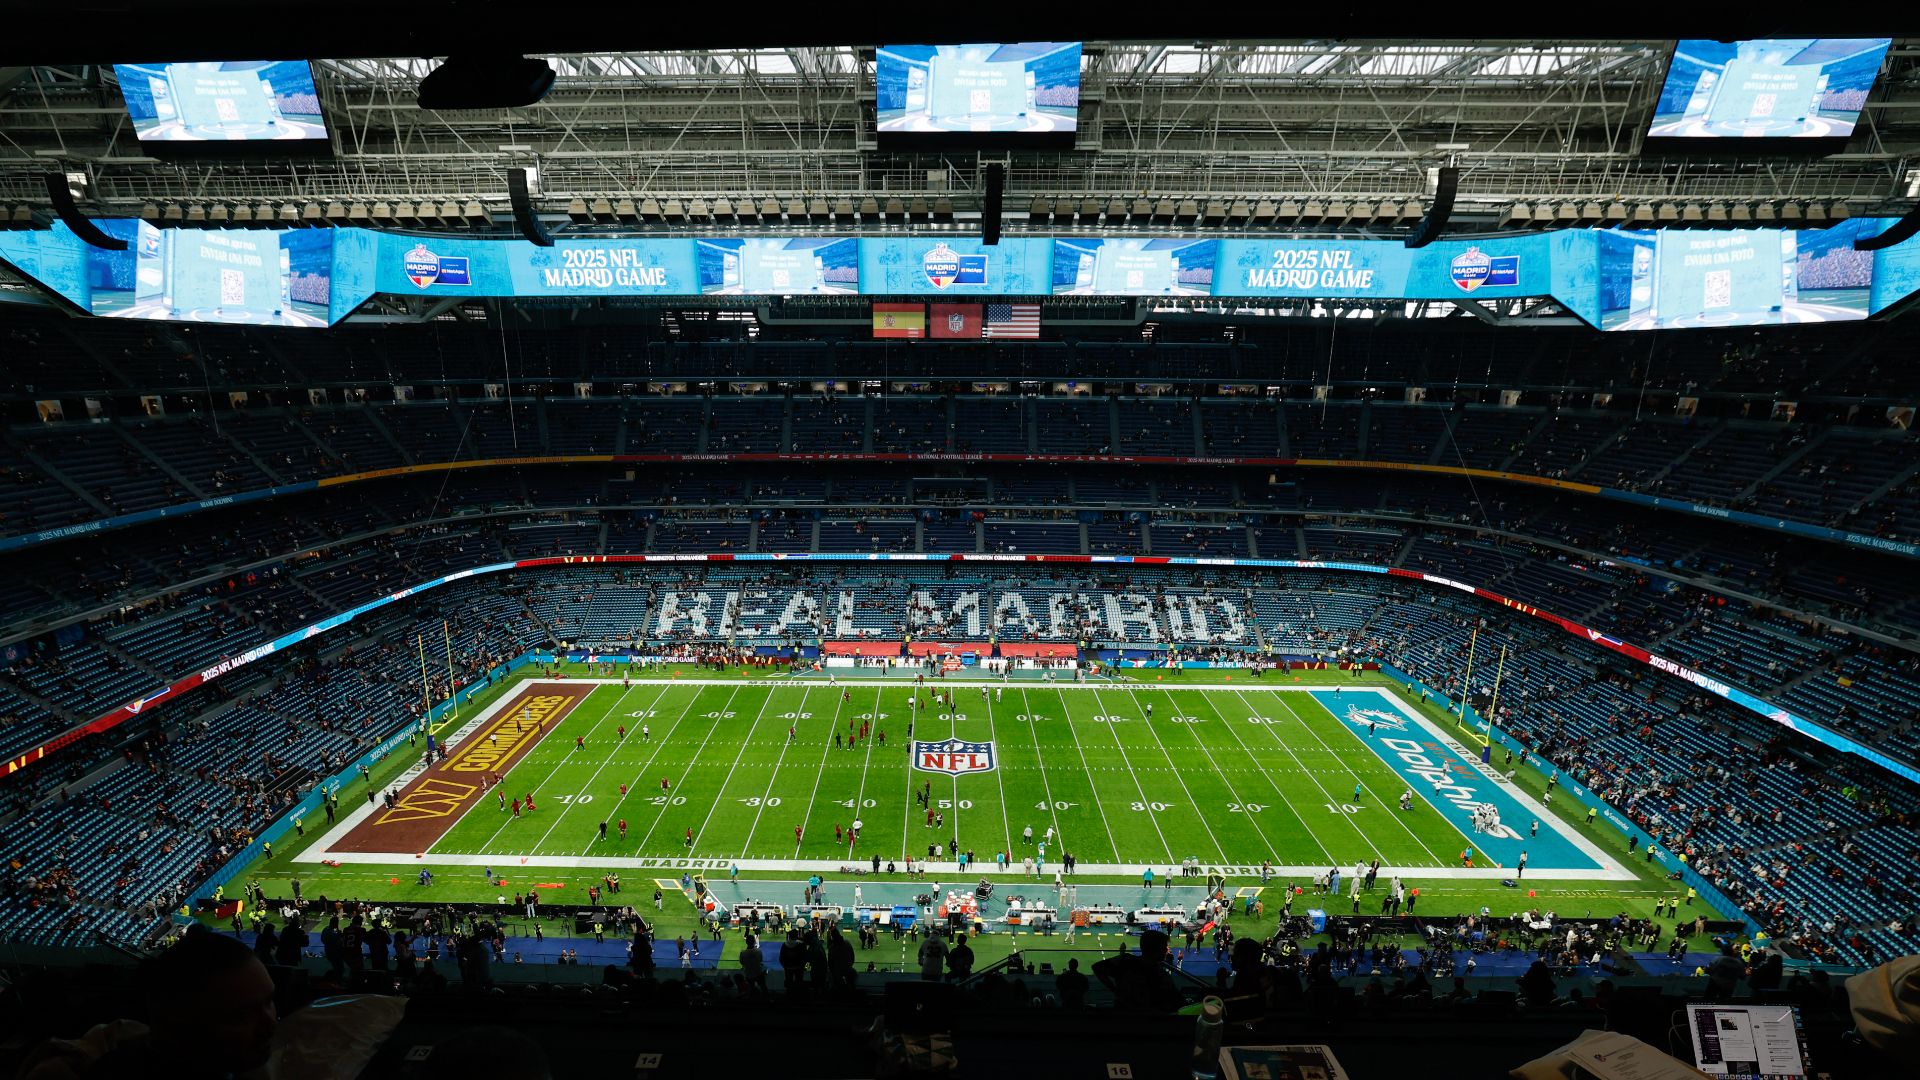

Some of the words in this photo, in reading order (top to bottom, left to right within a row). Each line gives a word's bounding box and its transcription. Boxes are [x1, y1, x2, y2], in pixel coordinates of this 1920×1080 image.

[562, 249, 607, 268] 2025
[609, 249, 643, 268] NFL
[1272, 250, 1318, 268] 2025
[1320, 250, 1353, 268] NFL
[1730, 247, 1755, 262] FOTO
[243, 254, 263, 267] FOTO
[406, 263, 437, 271] MADRID
[1453, 266, 1487, 275] MADRID
[543, 268, 613, 288] MADRID
[615, 268, 667, 286] GAME
[1247, 269, 1319, 289] MADRID
[1320, 269, 1374, 288] GAME
[53, 528, 65, 537] NFL
[63, 523, 86, 534] MADRID
[85, 521, 101, 531] GAME
[1860, 537, 1873, 546] NFL
[1872, 539, 1897, 551] MADRID
[1896, 544, 1917, 555] GAME
[655, 590, 882, 638] REAL
[201, 666, 220, 682] 2025
[218, 660, 233, 675] NFL
[231, 650, 257, 669] MADRID
[255, 641, 275, 658] GAME
[1648, 654, 1668, 670] 2025
[1665, 661, 1680, 676] NFL
[1678, 667, 1709, 688] MADRID
[1707, 679, 1731, 698] GAME
[631, 710, 659, 718] 10
[708, 710, 738, 718] 20
[785, 712, 814, 720] 30
[939, 713, 967, 721] 50
[1016, 714, 1046, 722] 40
[1247, 716, 1276, 724] 10
[452, 694, 566, 773] COMMANDERS
[922, 753, 988, 771] NFL
[560, 794, 593, 804] 10
[651, 795, 687, 806] 20
[745, 796, 782, 807] 30
[841, 798, 876, 809] 40
[937, 799, 973, 810] 50
[1034, 800, 1069, 811] 40
[1131, 801, 1167, 812] 30
[1227, 802, 1263, 813] 20
[1324, 803, 1359, 814] 10
[641, 859, 730, 868] MADRID
[641, 1056, 658, 1066] 14
[1111, 1066, 1129, 1077] 16
